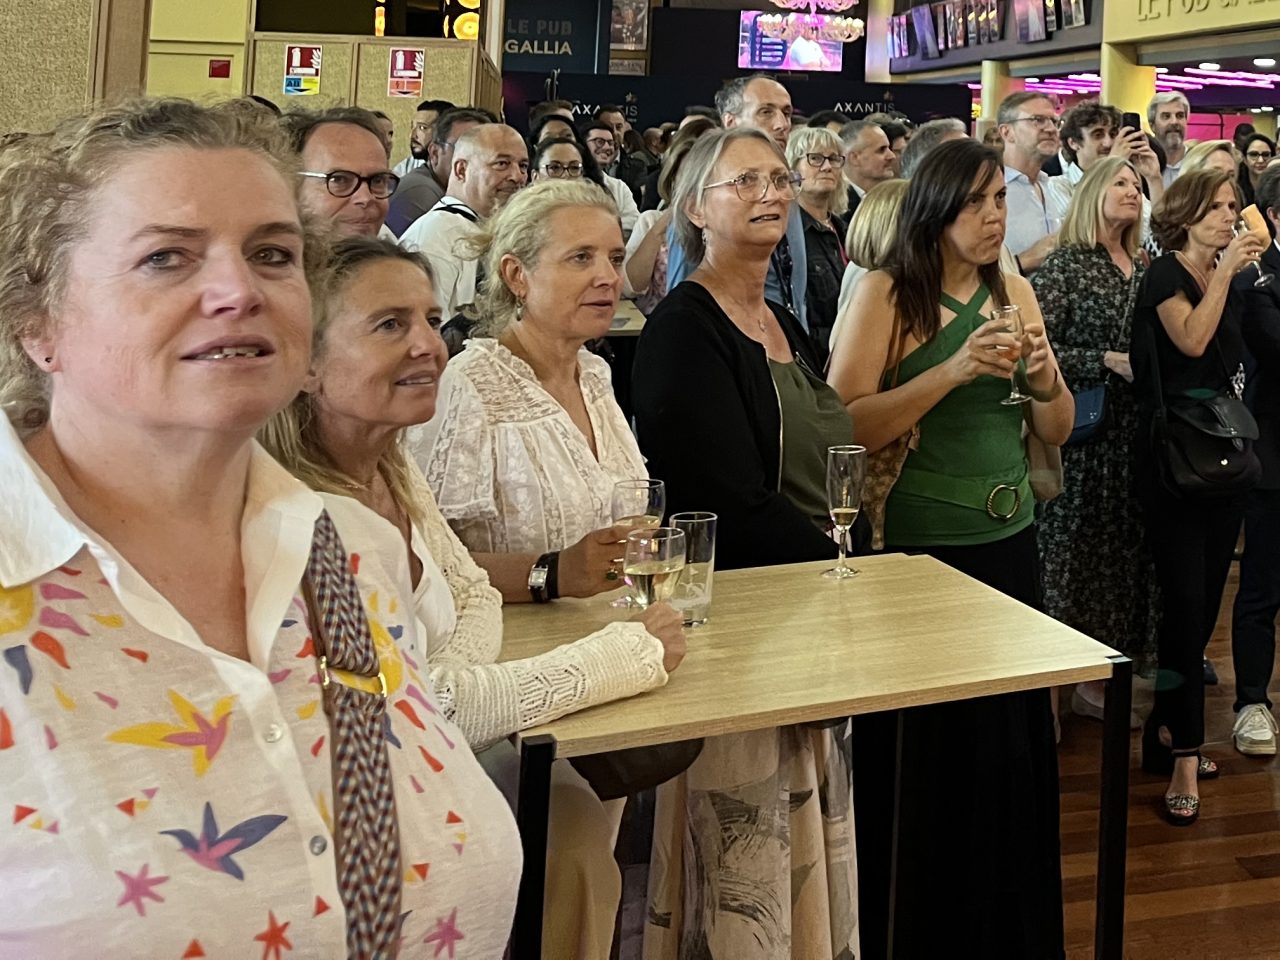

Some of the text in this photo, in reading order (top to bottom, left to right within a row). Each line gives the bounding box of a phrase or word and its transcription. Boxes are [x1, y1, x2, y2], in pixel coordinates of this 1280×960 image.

[507, 18, 572, 35] LE PUB
[504, 39, 573, 56] GALLIA
